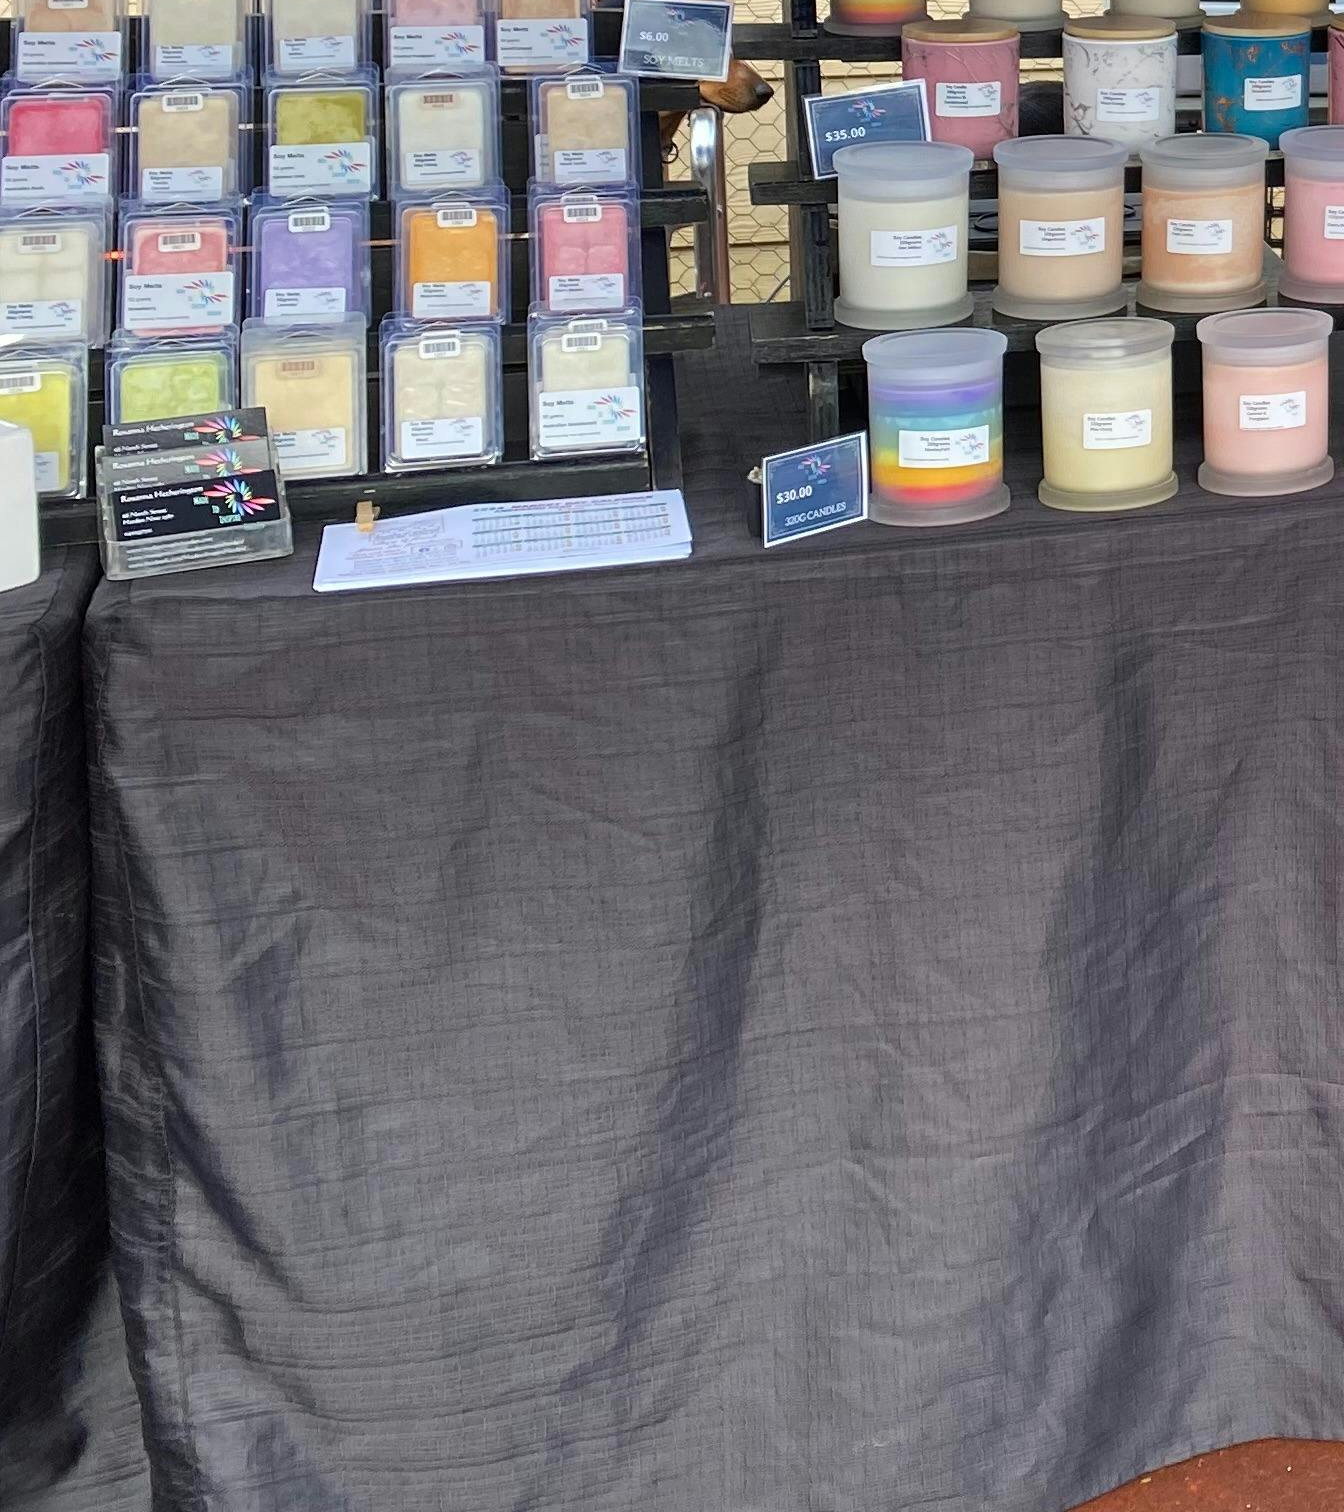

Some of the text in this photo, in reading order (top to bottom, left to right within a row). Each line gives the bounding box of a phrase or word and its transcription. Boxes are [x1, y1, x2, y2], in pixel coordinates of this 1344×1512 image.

[639, 31, 669, 43] $6.00
[643, 54, 705, 68] SOY MELTS
[824, 126, 866, 143] $35.00
[776, 484, 813, 505] $30.00
[784, 501, 847, 527] 320G CANDLES
